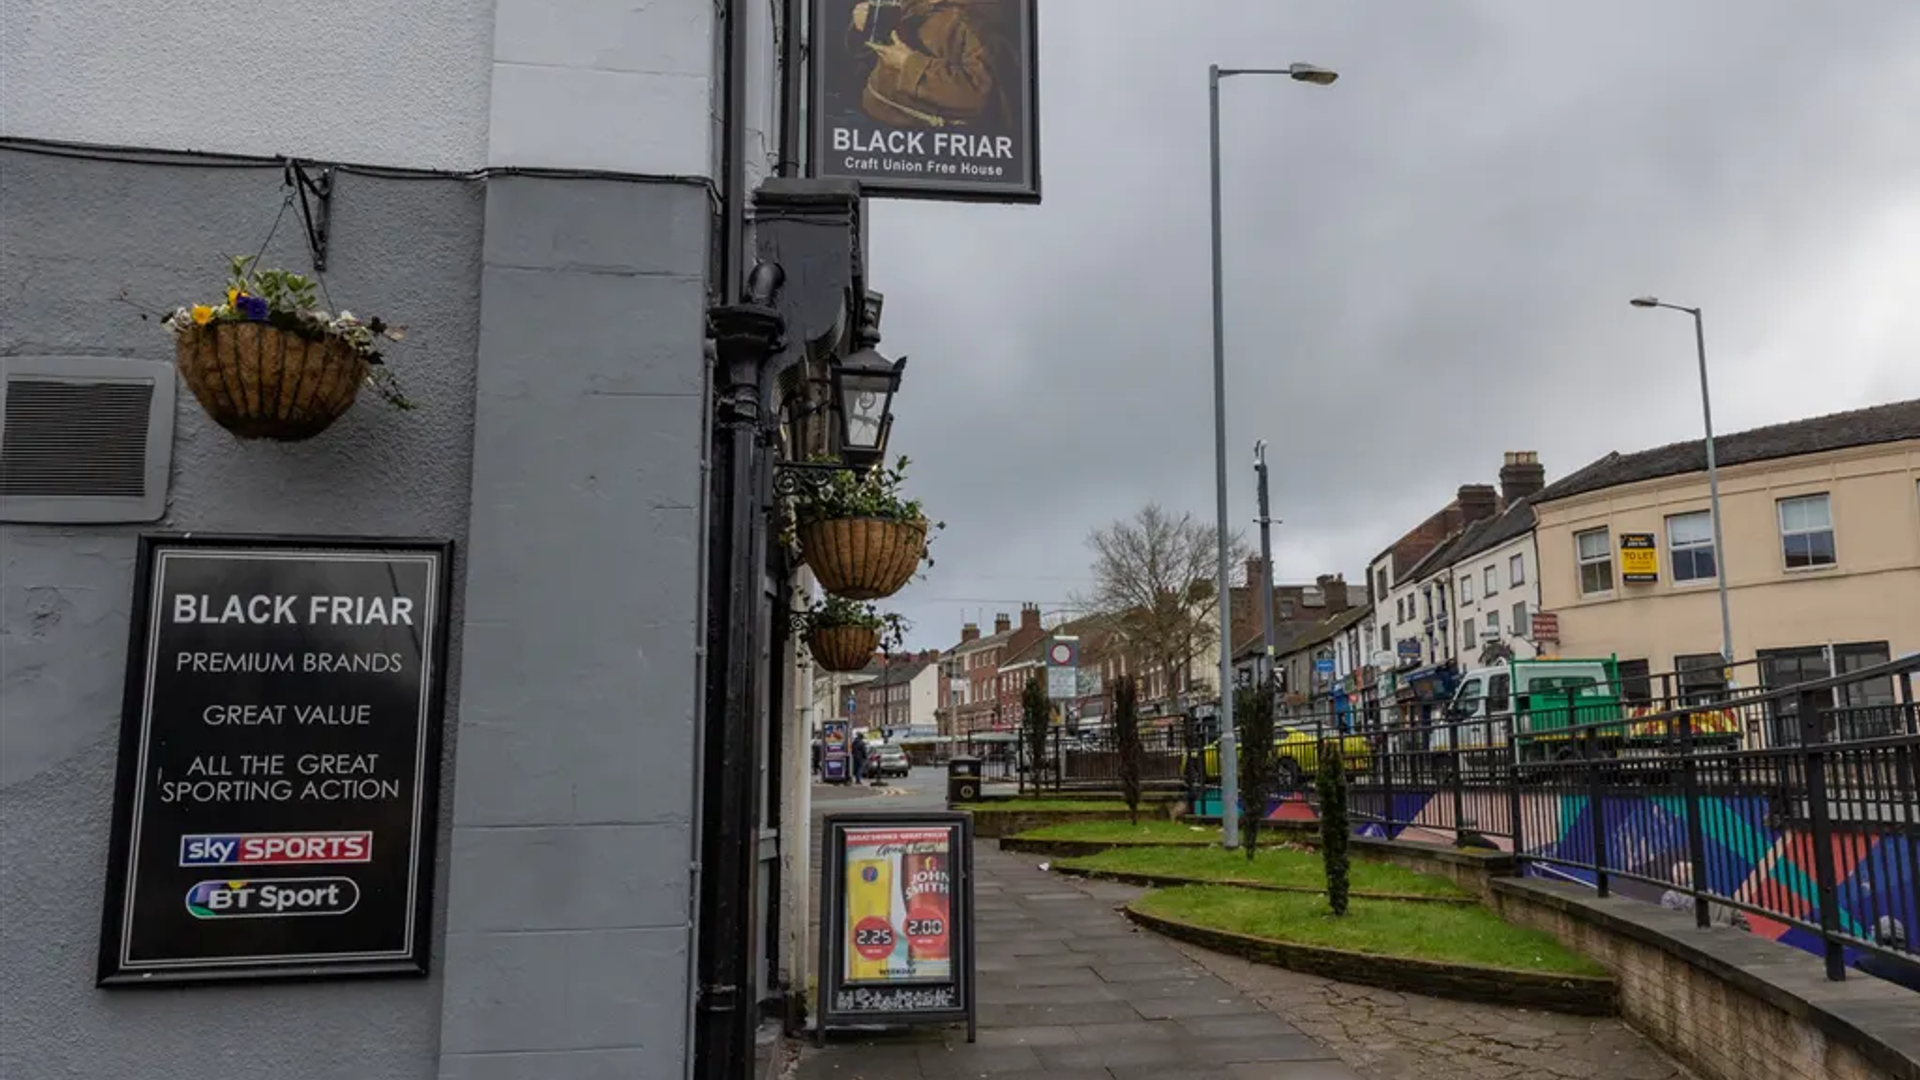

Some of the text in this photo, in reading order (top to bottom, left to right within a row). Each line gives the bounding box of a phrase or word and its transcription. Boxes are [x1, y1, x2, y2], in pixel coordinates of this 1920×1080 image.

[833, 128, 1013, 159] BLACK FRIAR
[844, 157, 1004, 176] Craft Union Free House
[1624, 551, 1654, 560] TO LET
[172, 594, 414, 626] BLACK FRIAR
[176, 651, 402, 673] PREMIUM BRANDS
[203, 704, 371, 726] GREAT VALUE
[186, 753, 379, 777] ALL THE GREAT
[161, 779, 400, 803] SPORTING ACTION
[188, 837, 364, 863] sky SPORTS
[911, 870, 950, 885] JOHN
[208, 884, 339, 911] BT Sport
[905, 881, 950, 901] SMITH
[857, 929, 892, 944] 2.25
[907, 920, 942, 935] 2.00
